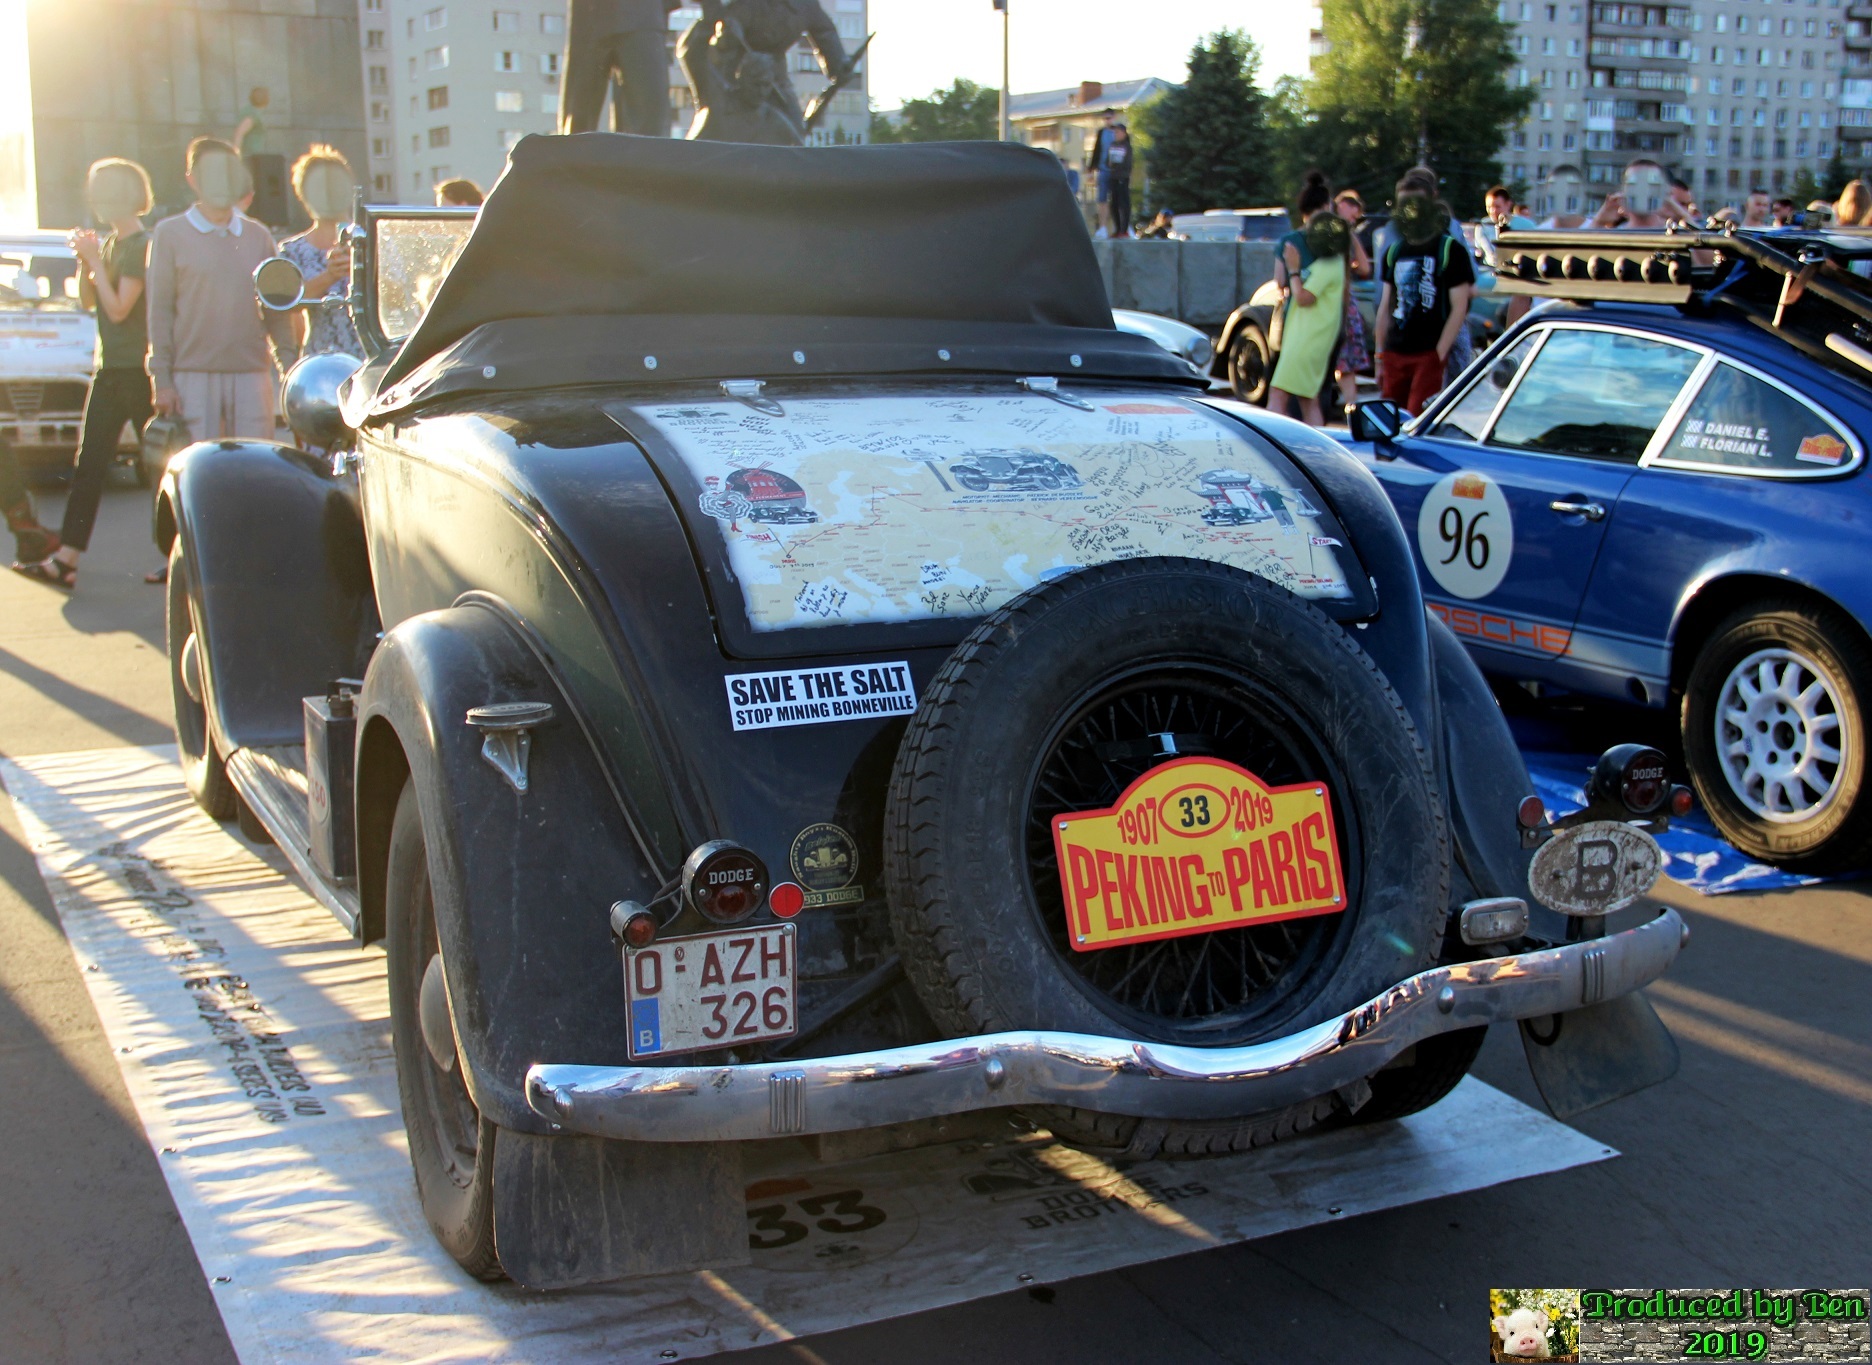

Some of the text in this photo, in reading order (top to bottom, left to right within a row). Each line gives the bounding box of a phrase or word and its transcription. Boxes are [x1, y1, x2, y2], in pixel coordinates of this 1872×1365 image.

[1699, 437, 1773, 457] FLORIAN L.
[1705, 422, 1771, 441] DANIEL E.
[1311, 537, 1333, 546] START
[1439, 506, 1489, 570] 96
[1427, 603, 1573, 655] RSCHE
[731, 666, 906, 706] SAVE THE SALT
[736, 695, 914, 726] STOP MINING BONNEVILLE
[1632, 767, 1663, 780] DODGE
[1117, 797, 1160, 846] 1907
[1178, 795, 1211, 828] 33
[1230, 786, 1274, 833] 2019
[708, 868, 754, 885] DODGE
[1067, 843, 1213, 935] PEKING
[1206, 871, 1226, 897] TO
[1222, 811, 1334, 913] PARIS
[1577, 839, 1618, 897] B
[803, 889, 858, 904] 933 DODGE
[700, 986, 788, 1040] 326
[640, 1030, 654, 1047] B
[748, 1189, 888, 1250] 33
